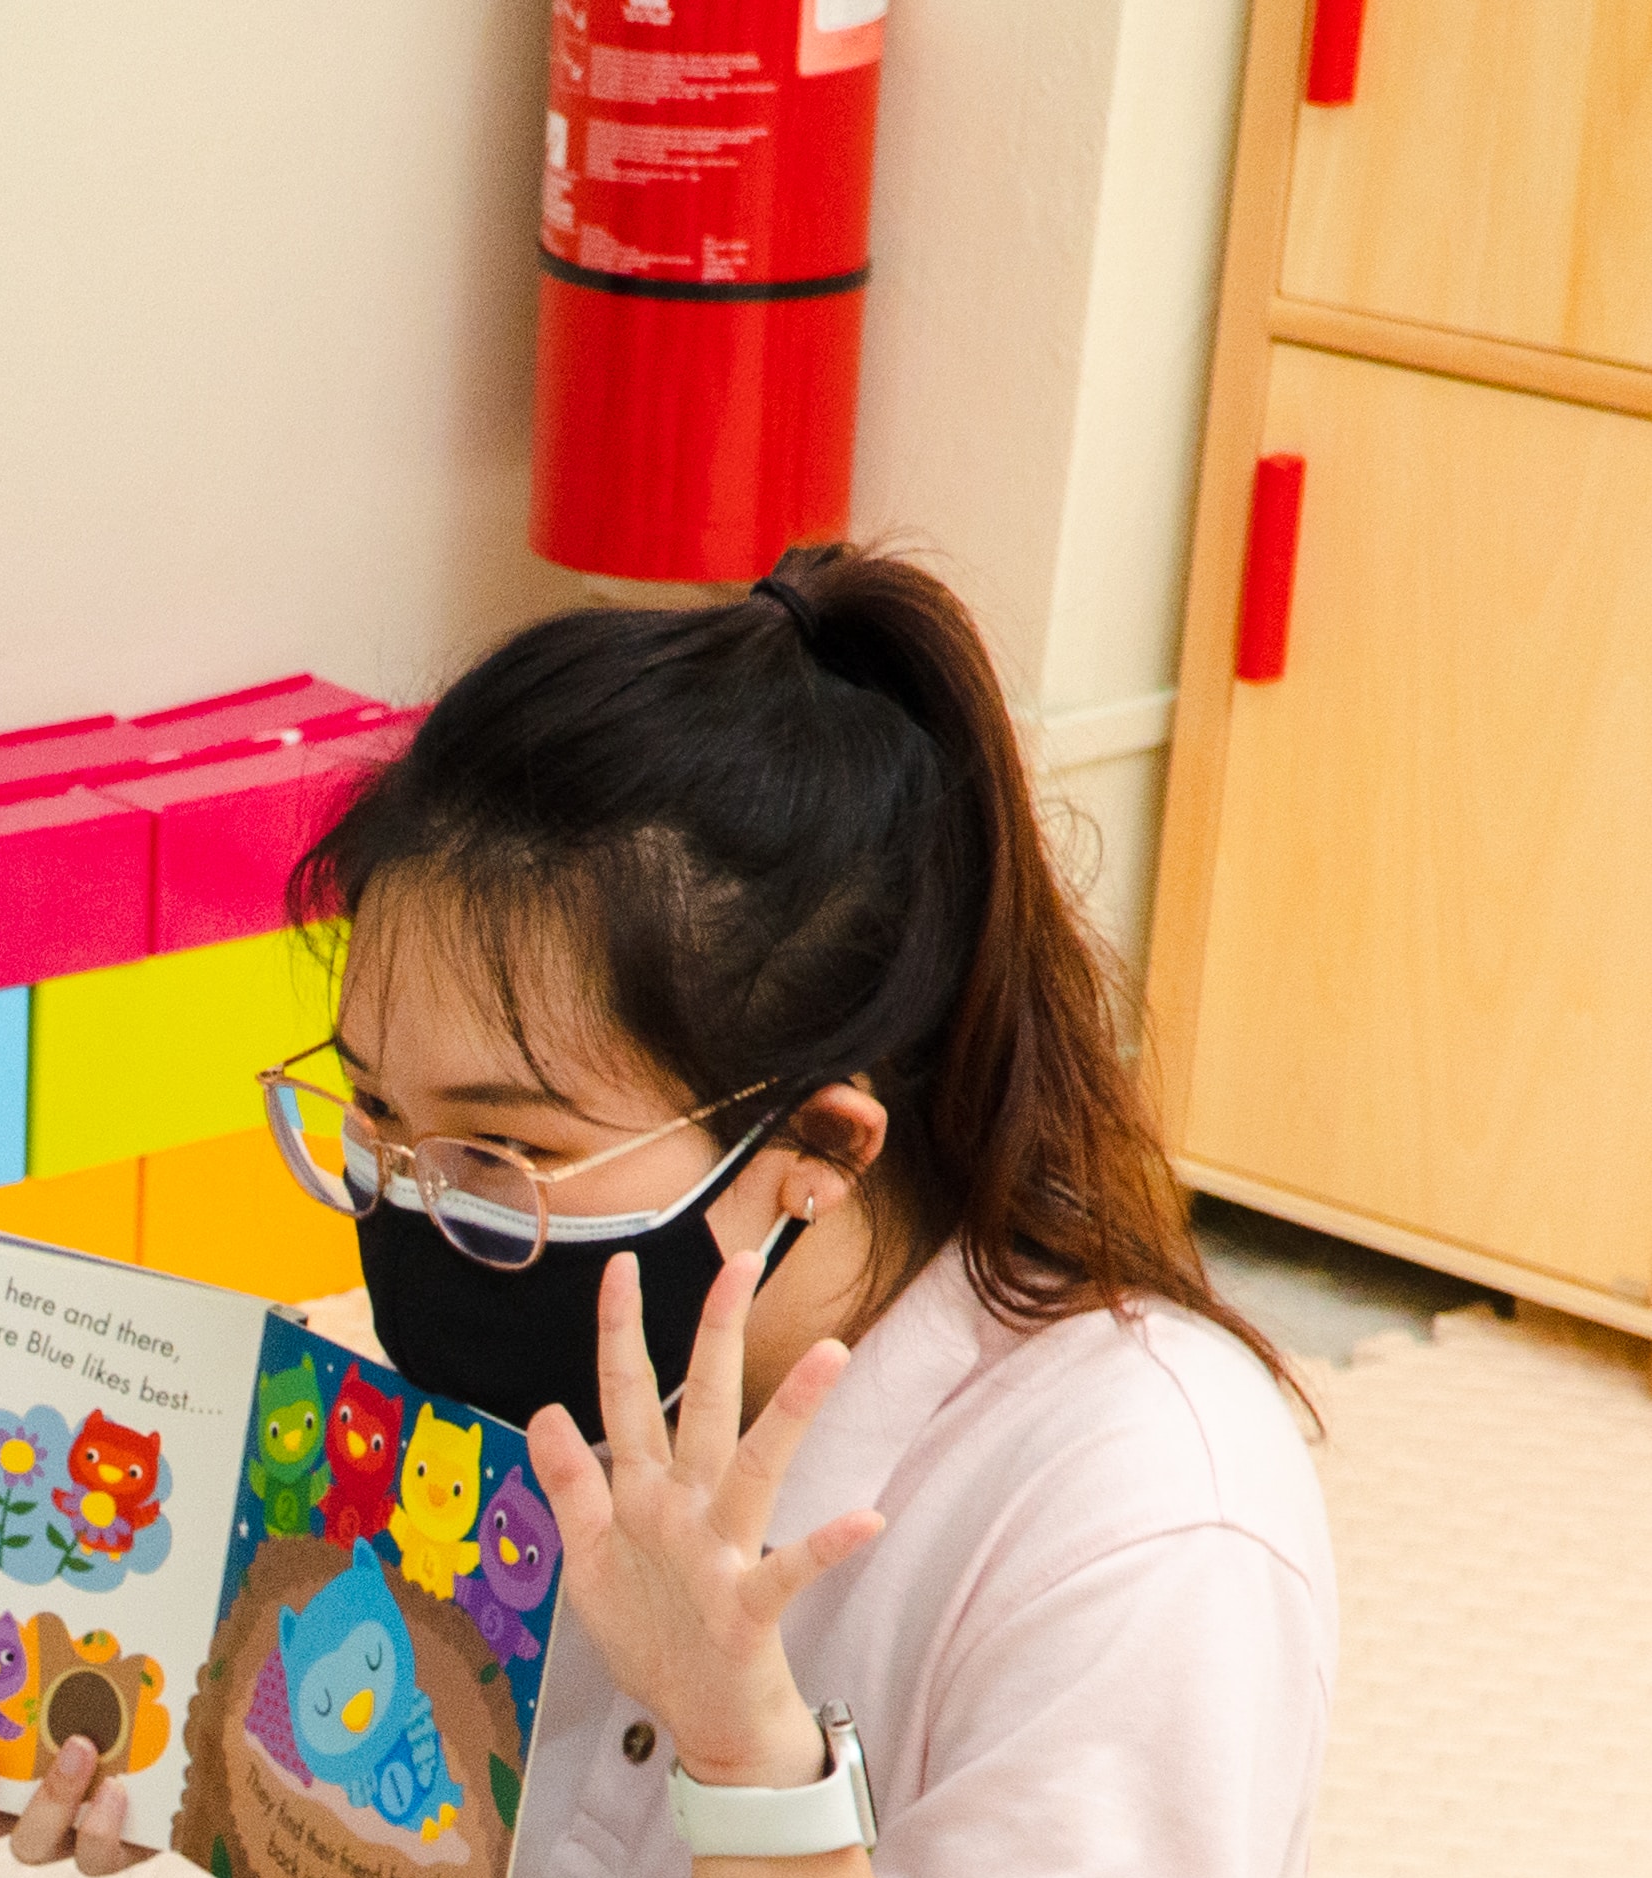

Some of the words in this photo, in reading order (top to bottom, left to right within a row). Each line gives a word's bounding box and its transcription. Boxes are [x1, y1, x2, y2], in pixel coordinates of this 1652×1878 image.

[5, 1277, 56, 1317] here
[63, 1308, 112, 1336] and
[117, 1319, 181, 1364] there,
[26, 1330, 75, 1369] Blue
[82, 1353, 130, 1395] likes
[247, 1762, 274, 1815] They
[266, 1829, 299, 1877] back
